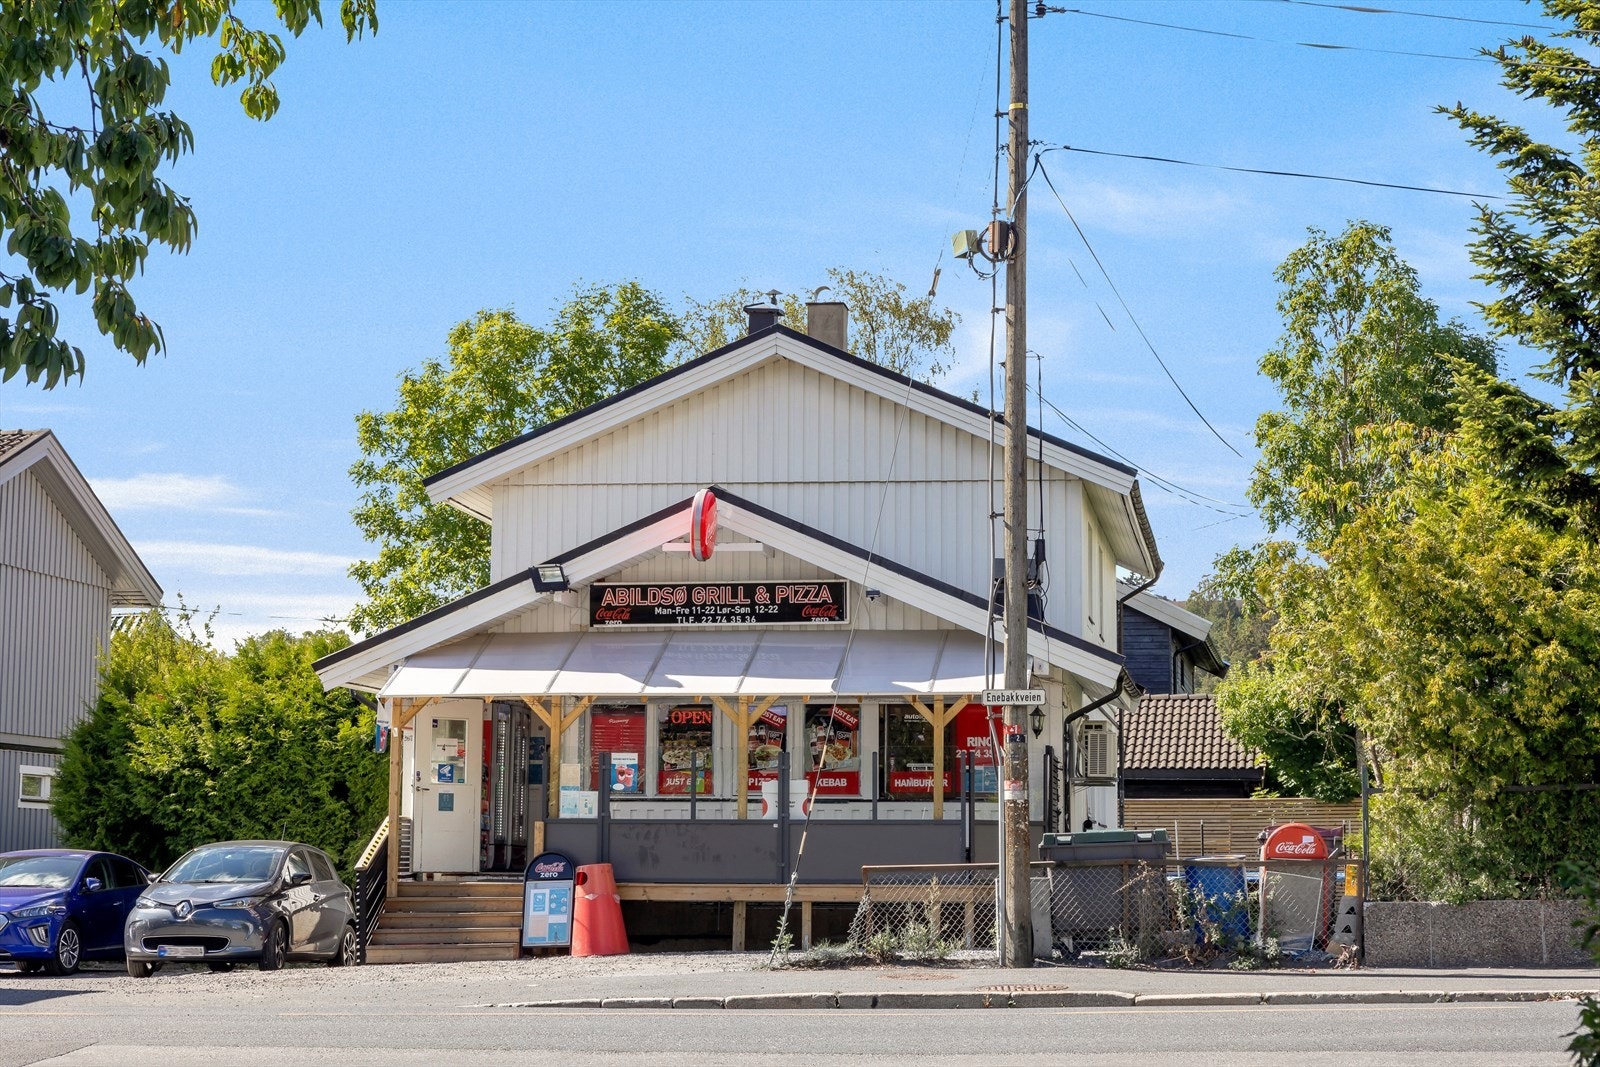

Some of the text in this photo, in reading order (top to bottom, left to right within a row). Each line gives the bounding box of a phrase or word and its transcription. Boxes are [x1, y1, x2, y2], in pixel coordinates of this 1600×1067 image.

[601, 585, 833, 607] ABILDSØ GRILL & PIZZA
[654, 605, 779, 615] Man-Fre 11-22 Lør-Søn 12-22
[701, 616, 715, 624] 22
[715, 616, 727, 624] 74
[730, 616, 742, 624] 35
[744, 615, 757, 623] 36
[986, 692, 1042, 702] Enebakkveien
[671, 710, 712, 724] OPEN
[772, 714, 786, 724] EAT
[845, 714, 858, 724] EAT
[665, 777, 701, 787] JUST ET
[816, 778, 847, 787] KEBAB
